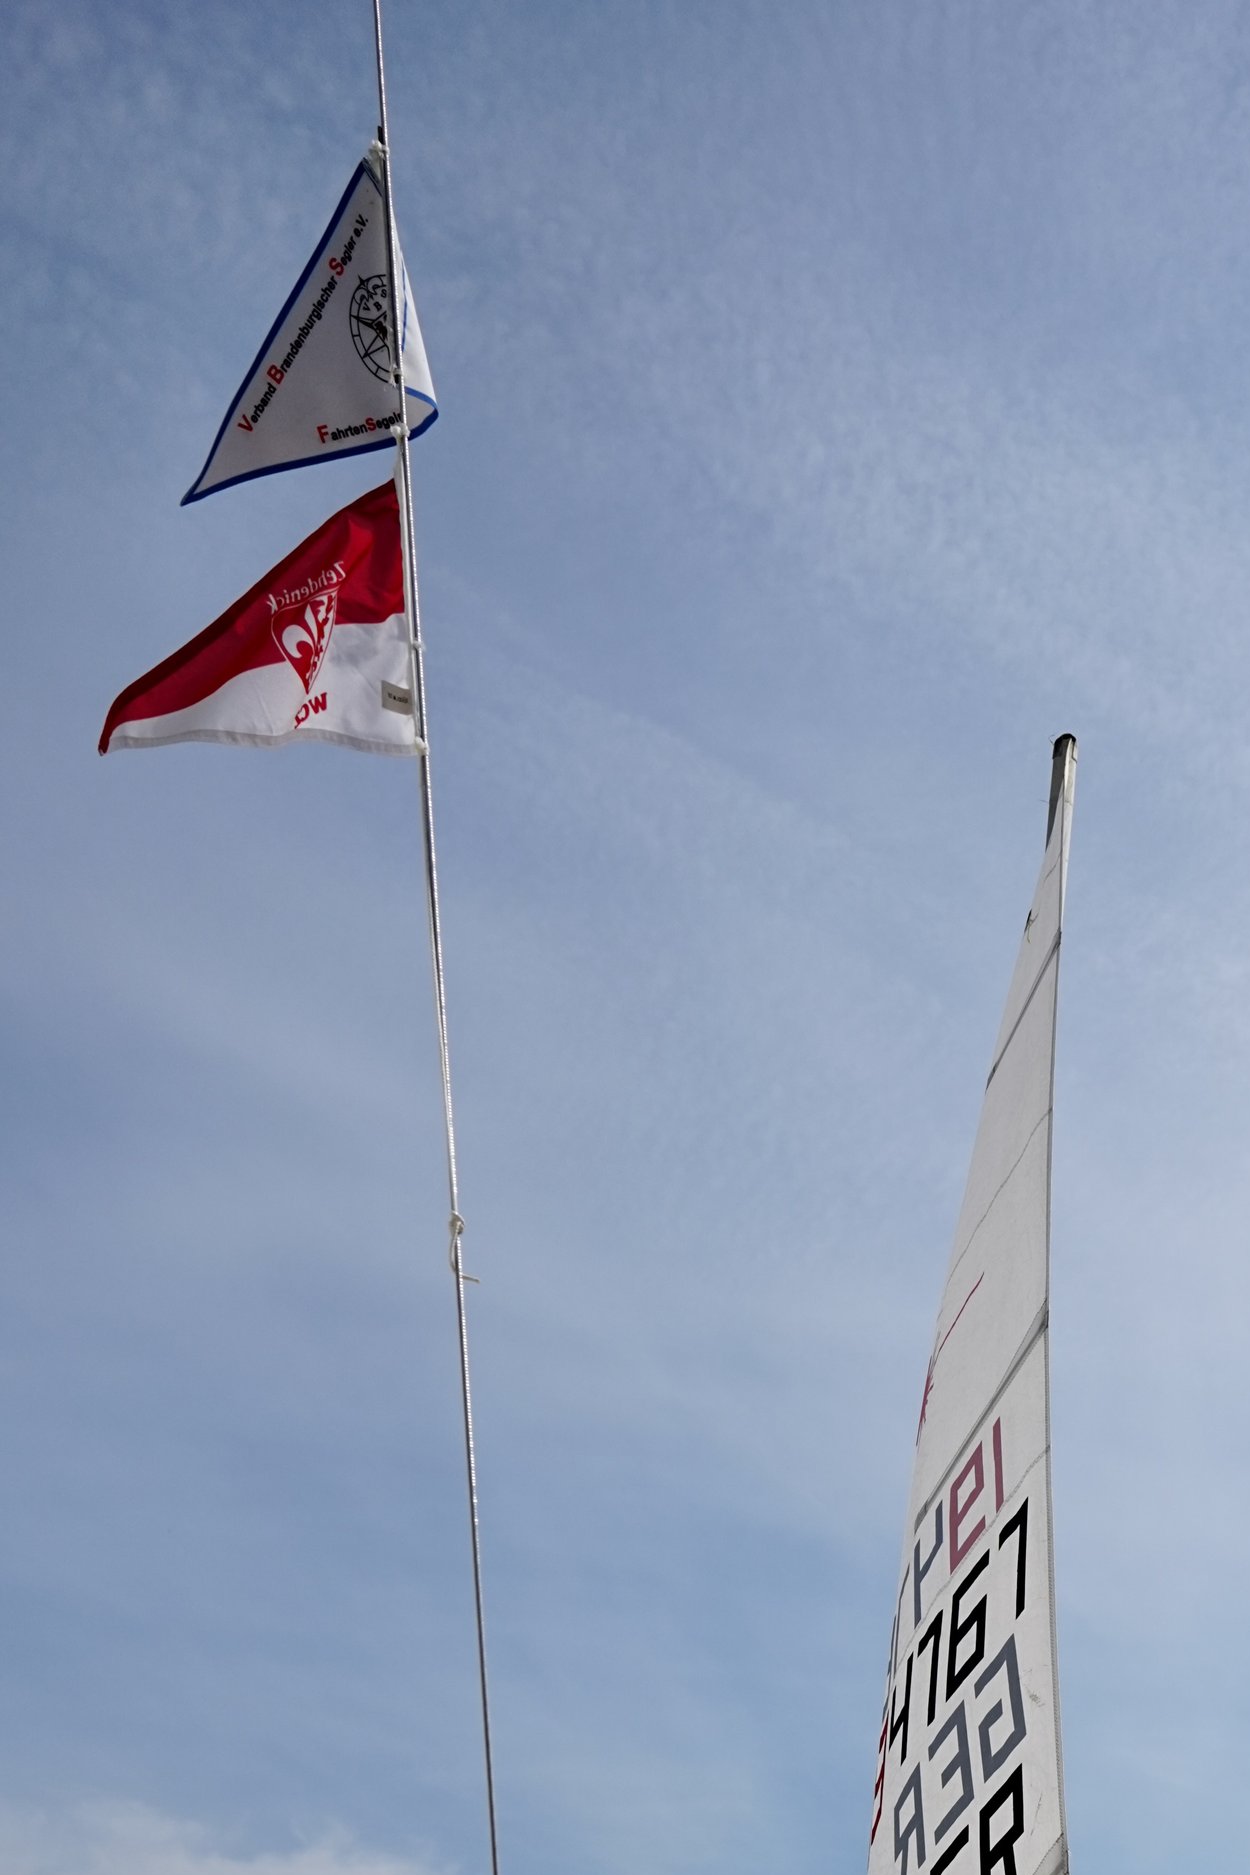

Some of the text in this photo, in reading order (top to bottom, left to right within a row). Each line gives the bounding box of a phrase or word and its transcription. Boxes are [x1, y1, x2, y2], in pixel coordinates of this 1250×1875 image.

[237, 214, 369, 433] Verband Brandenburgischer Segler e.V.
